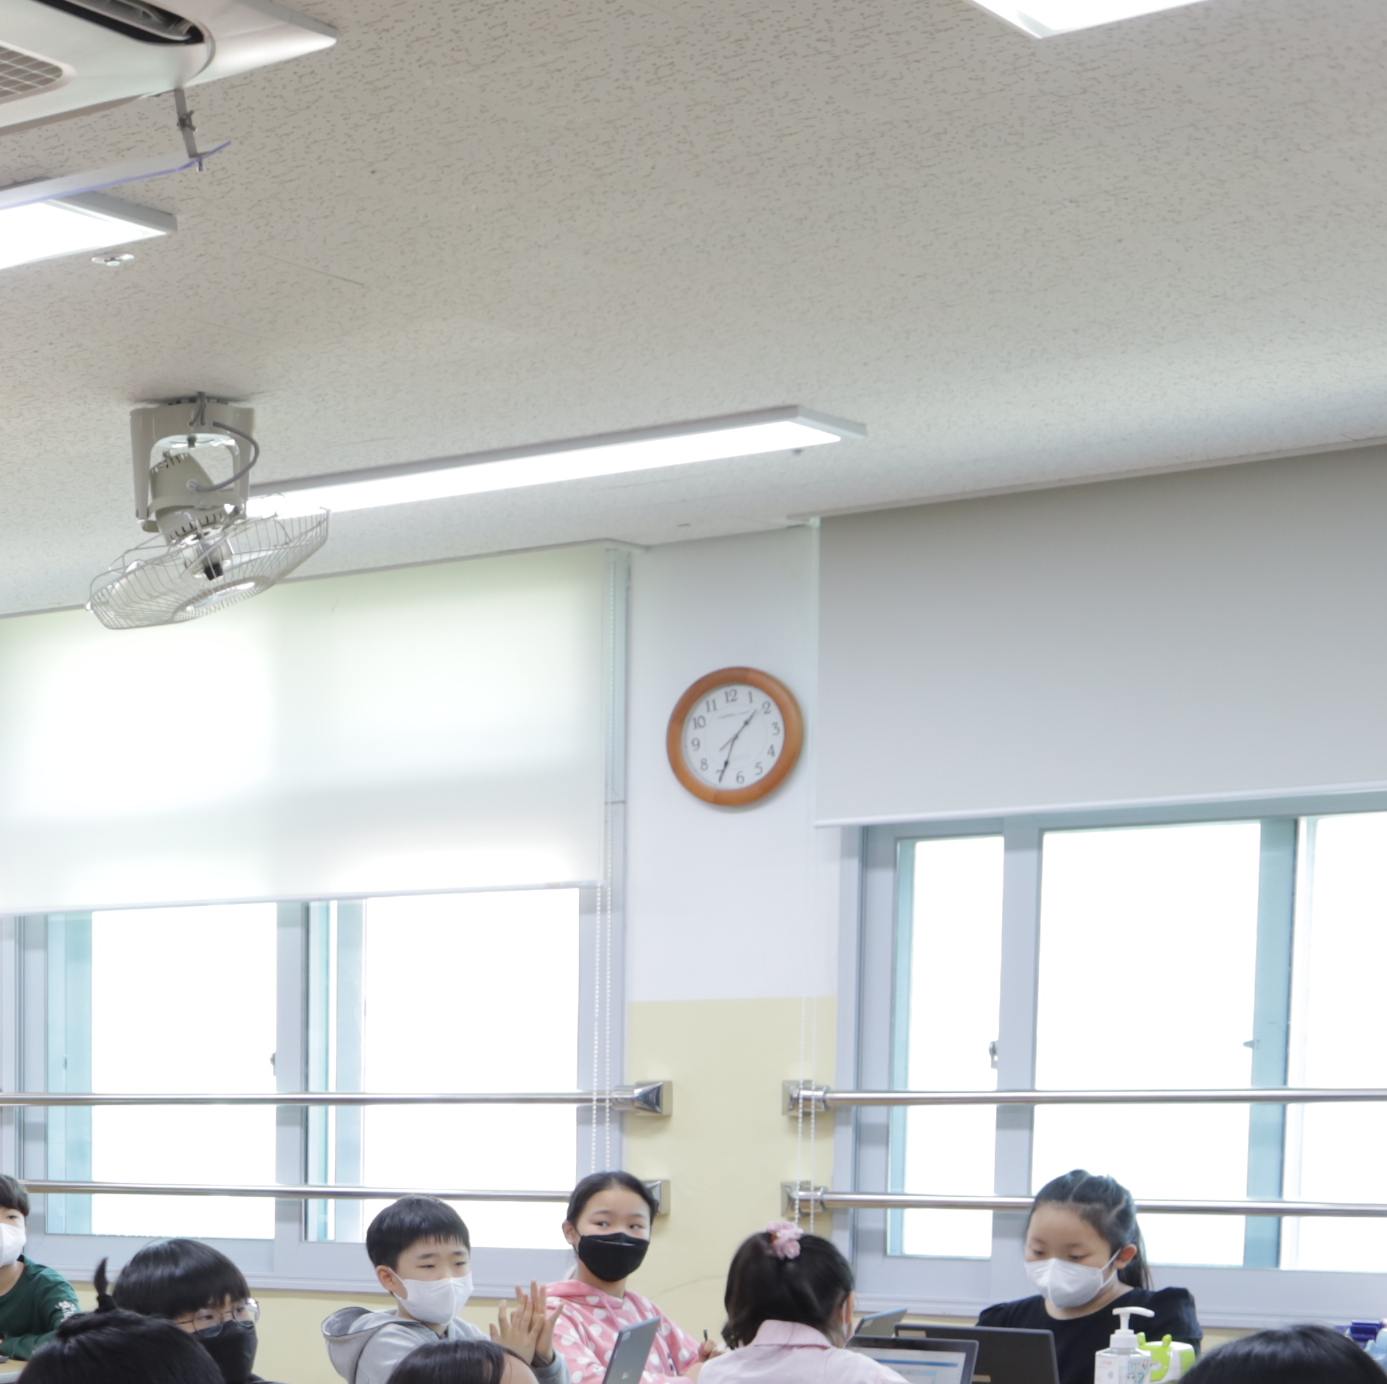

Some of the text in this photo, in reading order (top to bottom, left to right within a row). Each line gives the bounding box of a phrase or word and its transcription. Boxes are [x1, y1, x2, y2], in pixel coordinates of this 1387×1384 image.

[724, 688, 738, 704] 12
[748, 691, 754, 704] 1
[705, 699, 718, 713] 11
[762, 701, 772, 715] 2
[693, 715, 707, 730] 10
[771, 722, 781, 736] 3
[691, 738, 701, 751] 9
[767, 744, 776, 758] 4
[700, 758, 709, 771] 8
[754, 761, 764, 776] 5
[736, 771, 745, 784] 6
